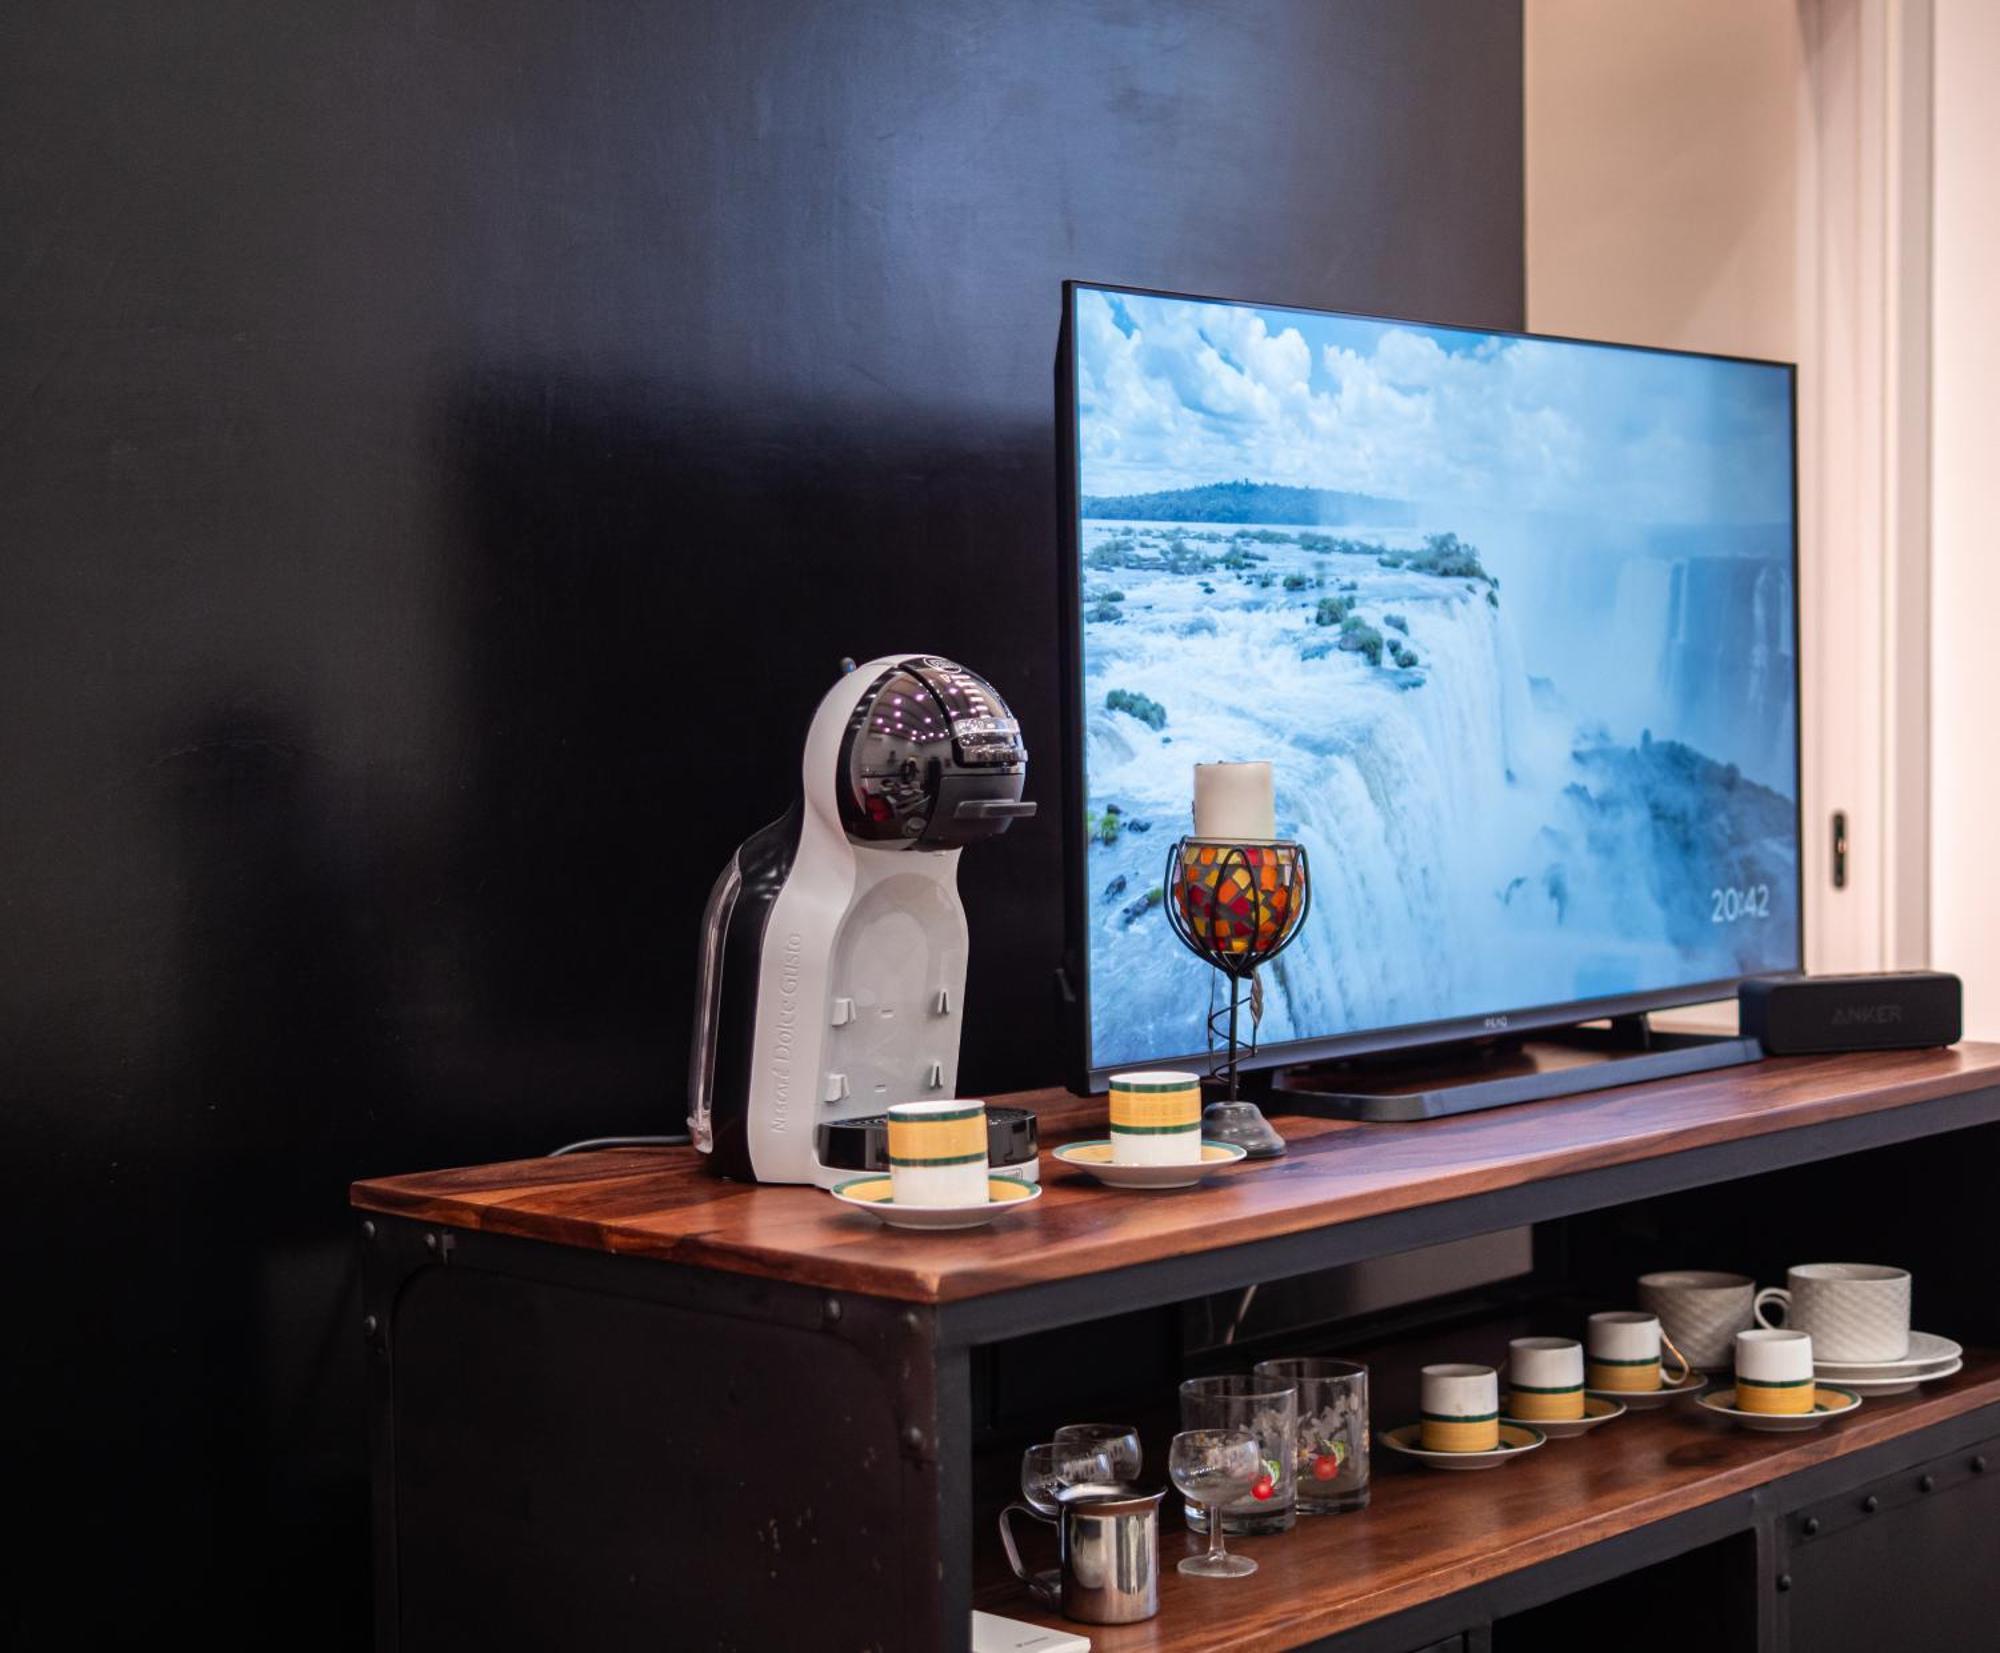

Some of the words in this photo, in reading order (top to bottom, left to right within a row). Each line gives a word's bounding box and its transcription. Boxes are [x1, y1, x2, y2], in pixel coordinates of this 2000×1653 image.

[1711, 884, 1770, 923] 20:42
[778, 933, 801, 996] Gusto
[772, 1000, 796, 1063] Dolce
[1831, 1005, 1903, 1025] ANKER
